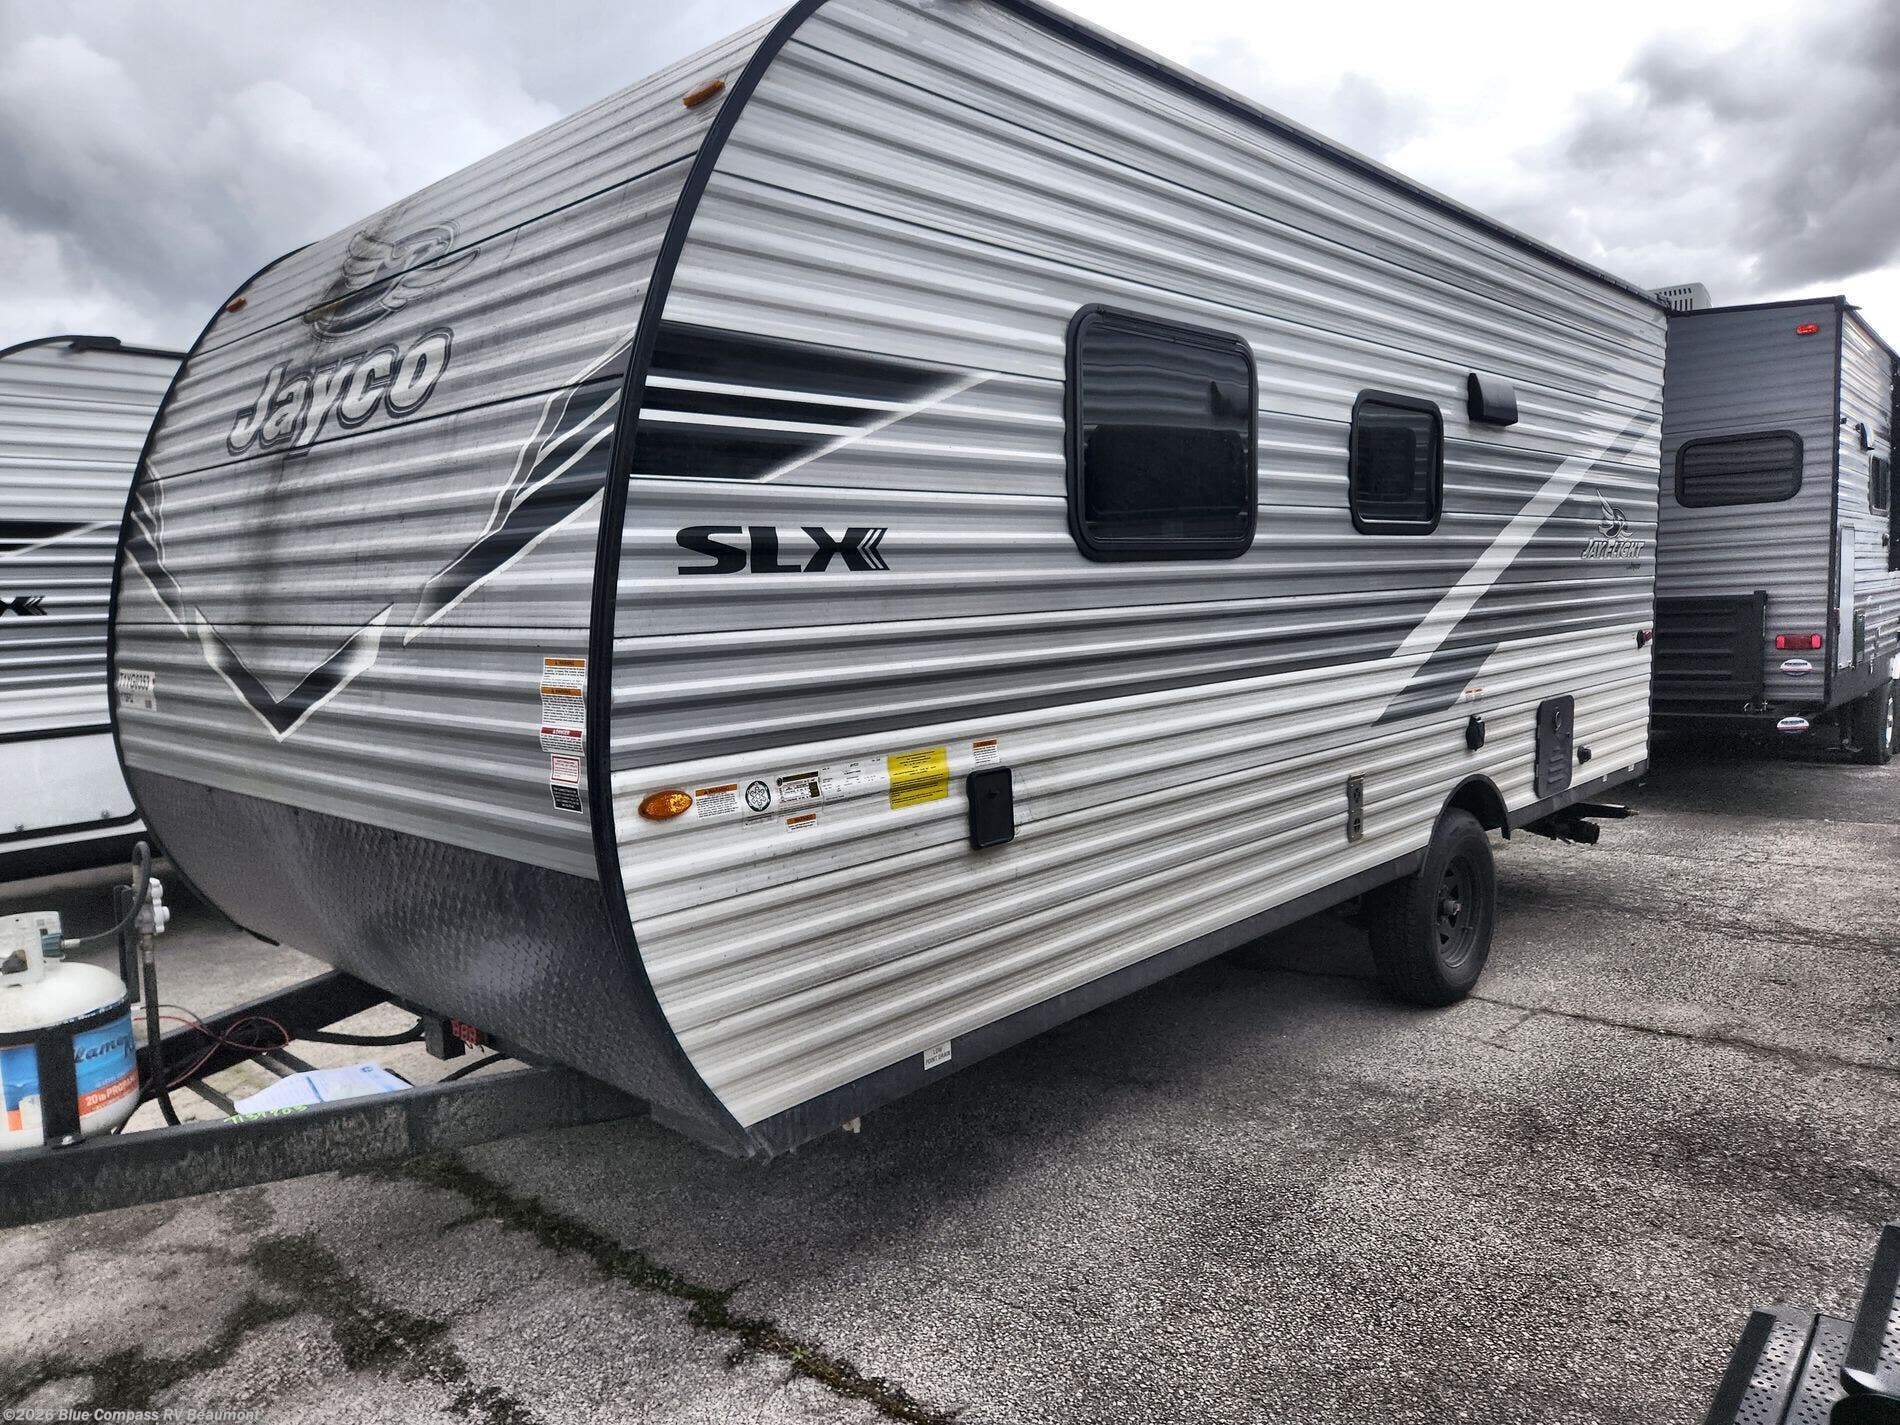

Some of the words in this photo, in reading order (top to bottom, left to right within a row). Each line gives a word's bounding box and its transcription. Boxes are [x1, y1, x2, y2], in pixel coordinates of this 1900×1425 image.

[226, 327, 454, 457] Jayco
[676, 525, 890, 575] SLX
[1604, 539, 1645, 559] FLIGHT
